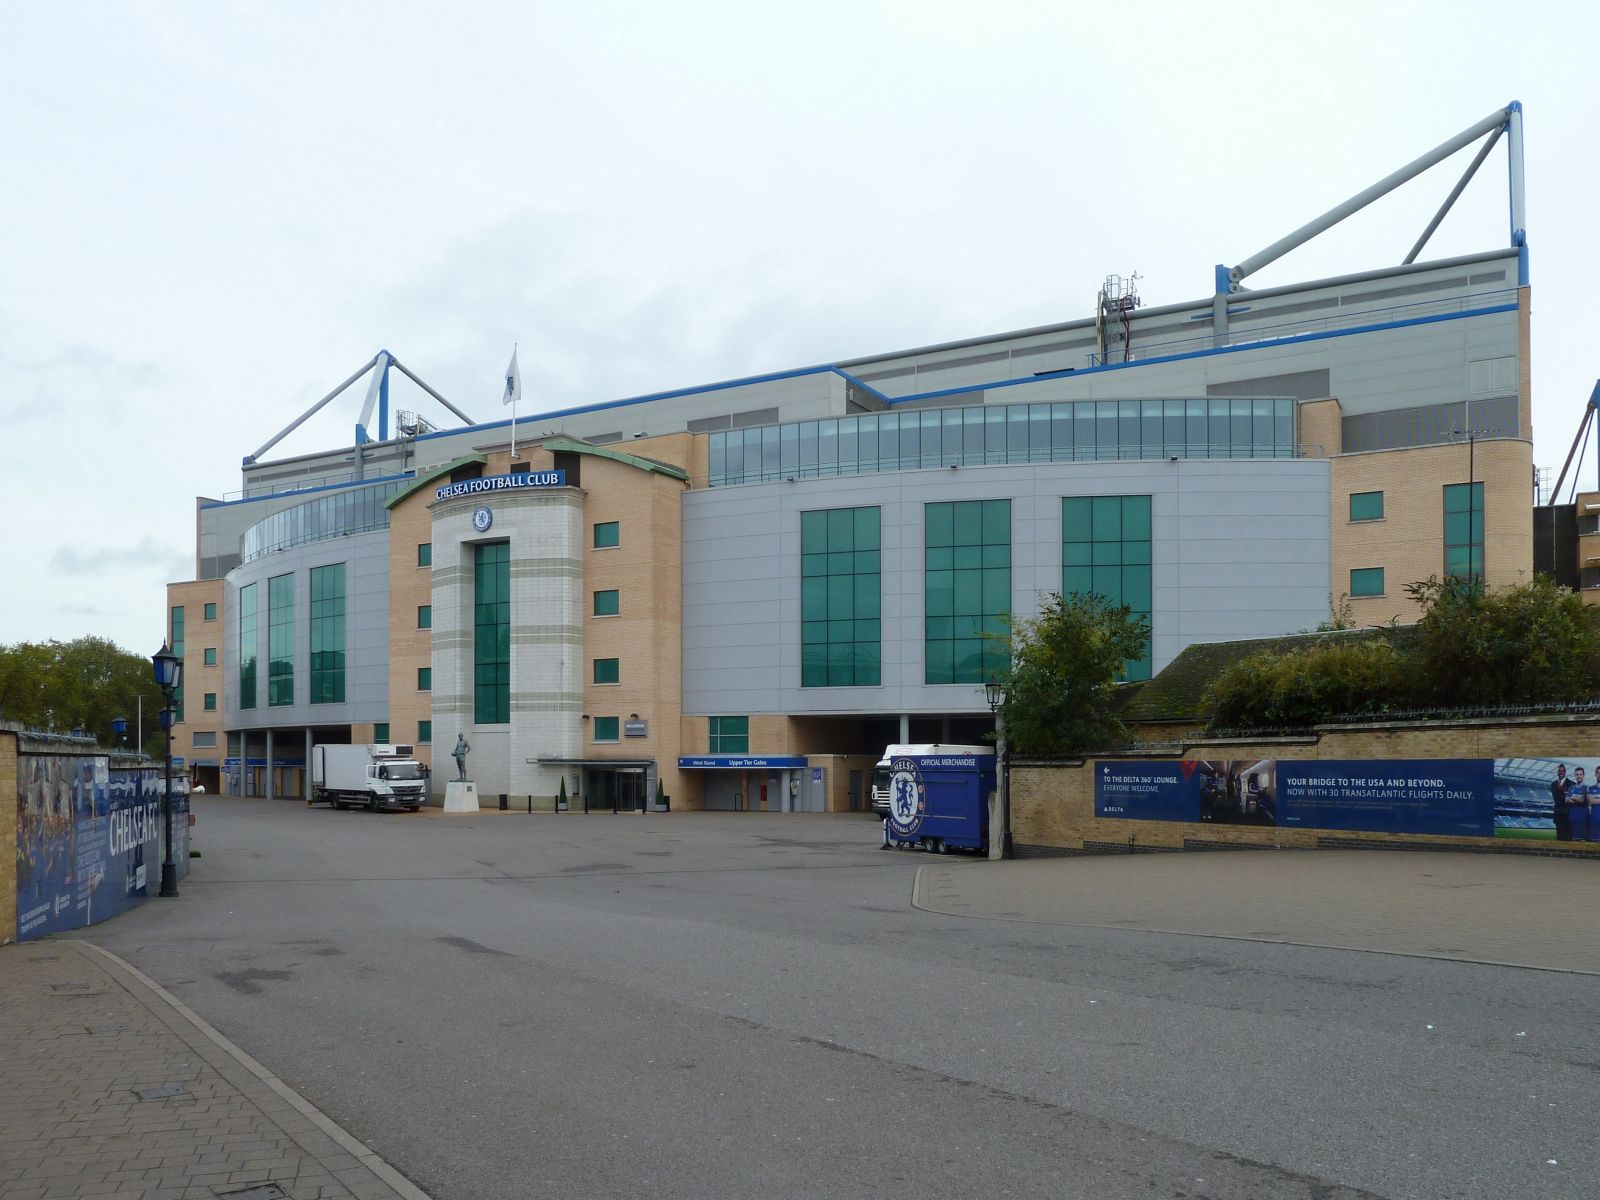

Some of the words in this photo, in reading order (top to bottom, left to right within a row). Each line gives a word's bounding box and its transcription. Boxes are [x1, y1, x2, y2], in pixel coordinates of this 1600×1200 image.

[436, 483, 469, 499] CHELSEA
[470, 475, 525, 492] FOOTBALL
[527, 473, 559, 486] CLUB
[728, 759, 743, 767] Upper
[942, 758, 976, 766] MERCHANDISE
[889, 760, 917, 778] CHELSEA
[1103, 784, 1130, 792] EVERYONE
[1287, 778, 1307, 786] YOUR
[1308, 778, 1336, 787] BRIDGE
[1338, 778, 1349, 786] TO
[1351, 778, 1366, 787] THE
[1368, 778, 1385, 787] USA
[1387, 778, 1406, 787] AND
[1408, 779, 1446, 788] BEYOND.
[1287, 788, 1306, 796] NOW
[1307, 788, 1328, 796] WITH
[1330, 788, 1339, 797] 30
[1341, 788, 1407, 798] TRANSATLANTIC
[1409, 789, 1444, 799] FLIGHTS
[1446, 790, 1474, 800] DAILY.
[110, 805, 147, 857] CHELSEA
[148, 802, 158, 841] FC
